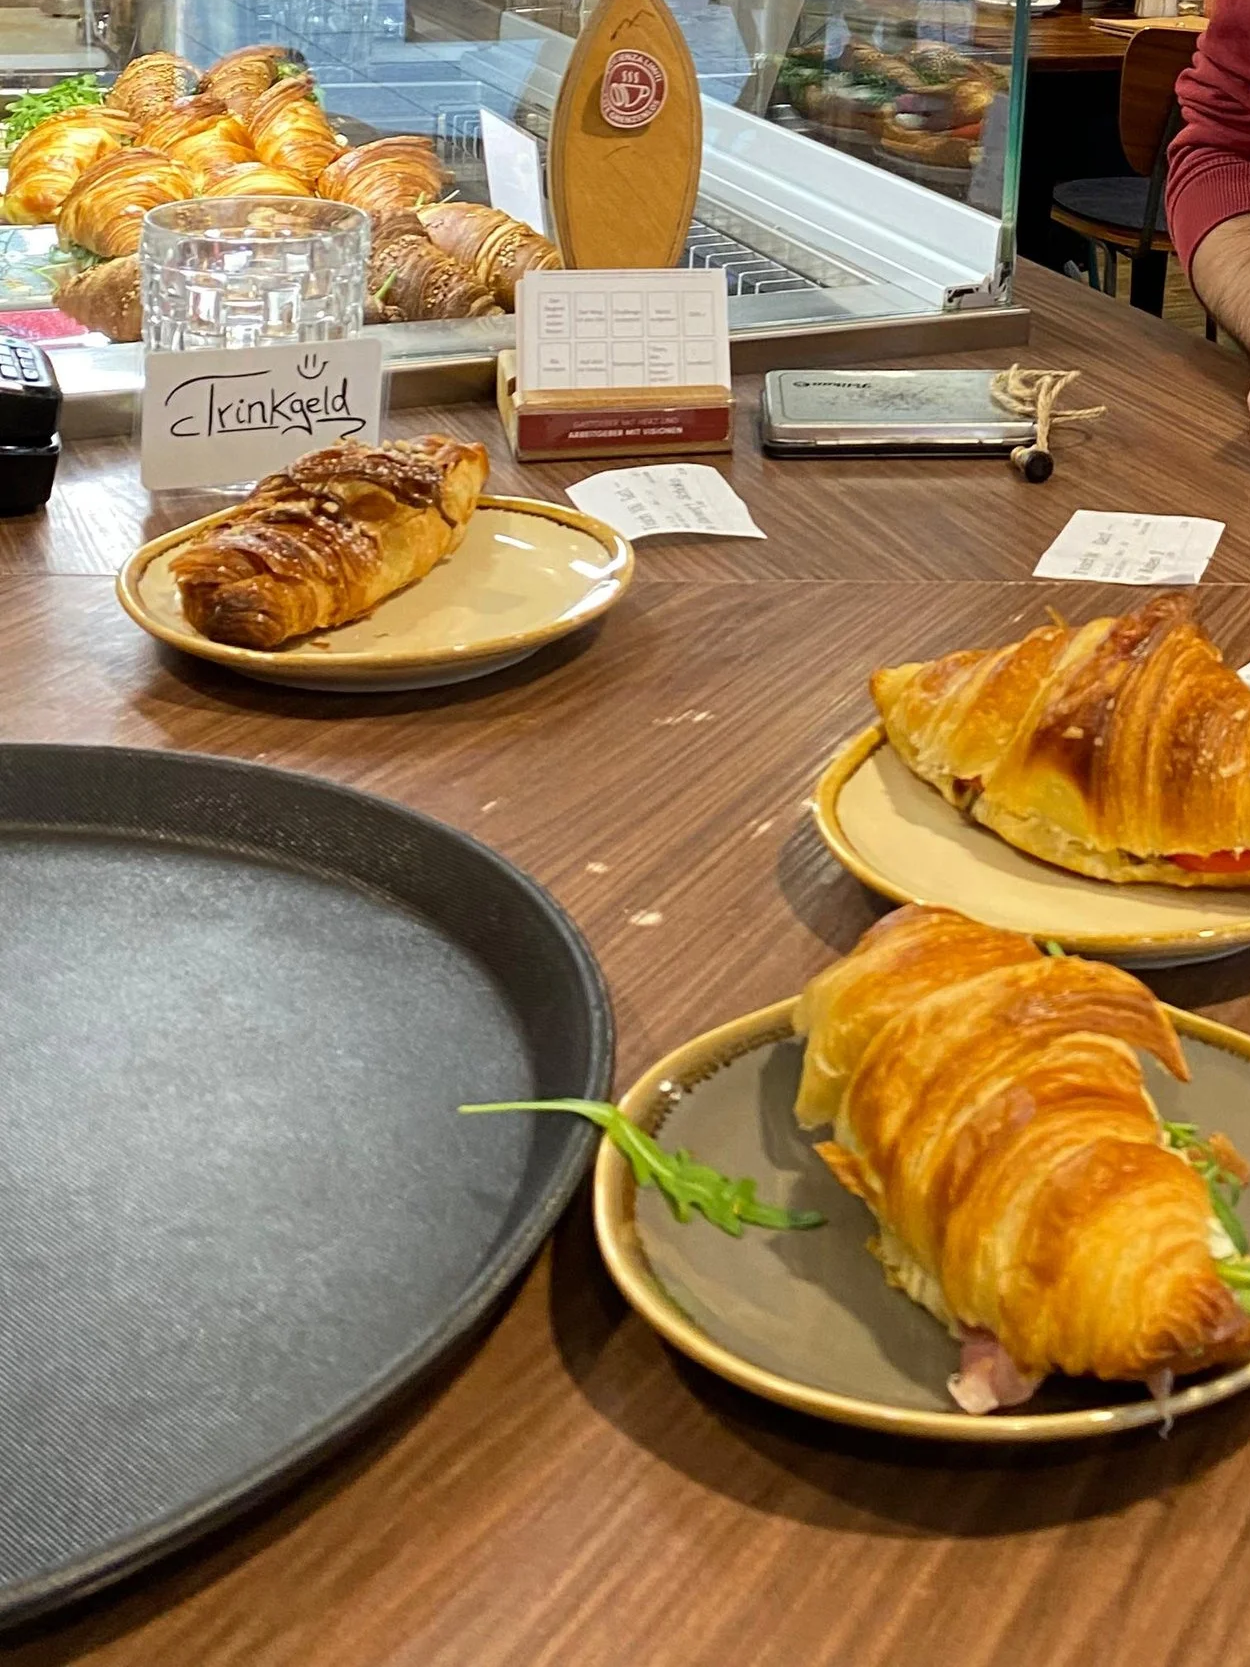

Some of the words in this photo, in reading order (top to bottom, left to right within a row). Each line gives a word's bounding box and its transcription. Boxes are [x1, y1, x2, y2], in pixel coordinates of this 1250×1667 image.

[165, 369, 358, 437] Trinkgeld
[625, 427, 641, 437] MIT
[643, 426, 683, 436] VISIONEN
